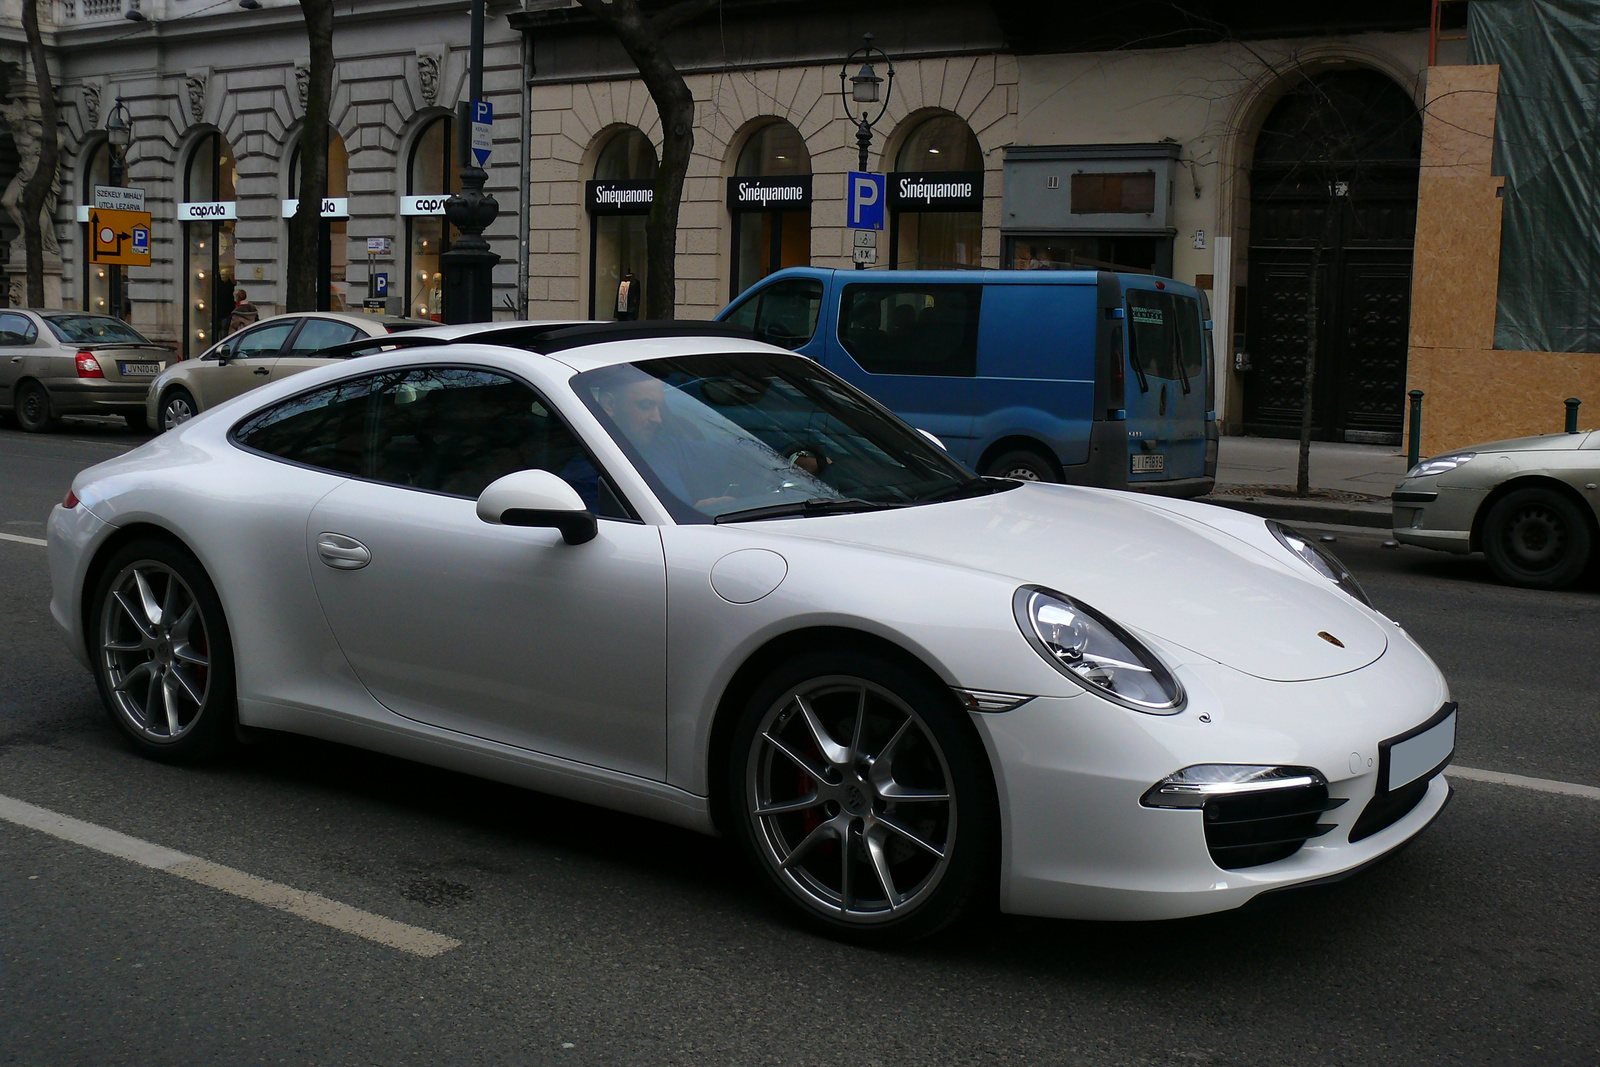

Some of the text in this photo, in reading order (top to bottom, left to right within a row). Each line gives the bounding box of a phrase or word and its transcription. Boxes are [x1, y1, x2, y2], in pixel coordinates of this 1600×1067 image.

[477, 102, 488, 121] P
[123, 192, 142, 200] MIHÁLY
[596, 185, 653, 208] Sinéquanone
[739, 182, 803, 206] Sinéquanone
[899, 178, 972, 204] Sinéquanone
[98, 201, 114, 209] UTCA
[854, 178, 878, 223] P
[190, 204, 225, 218] capsula
[135, 230, 145, 244] P
[377, 277, 386, 291] P
